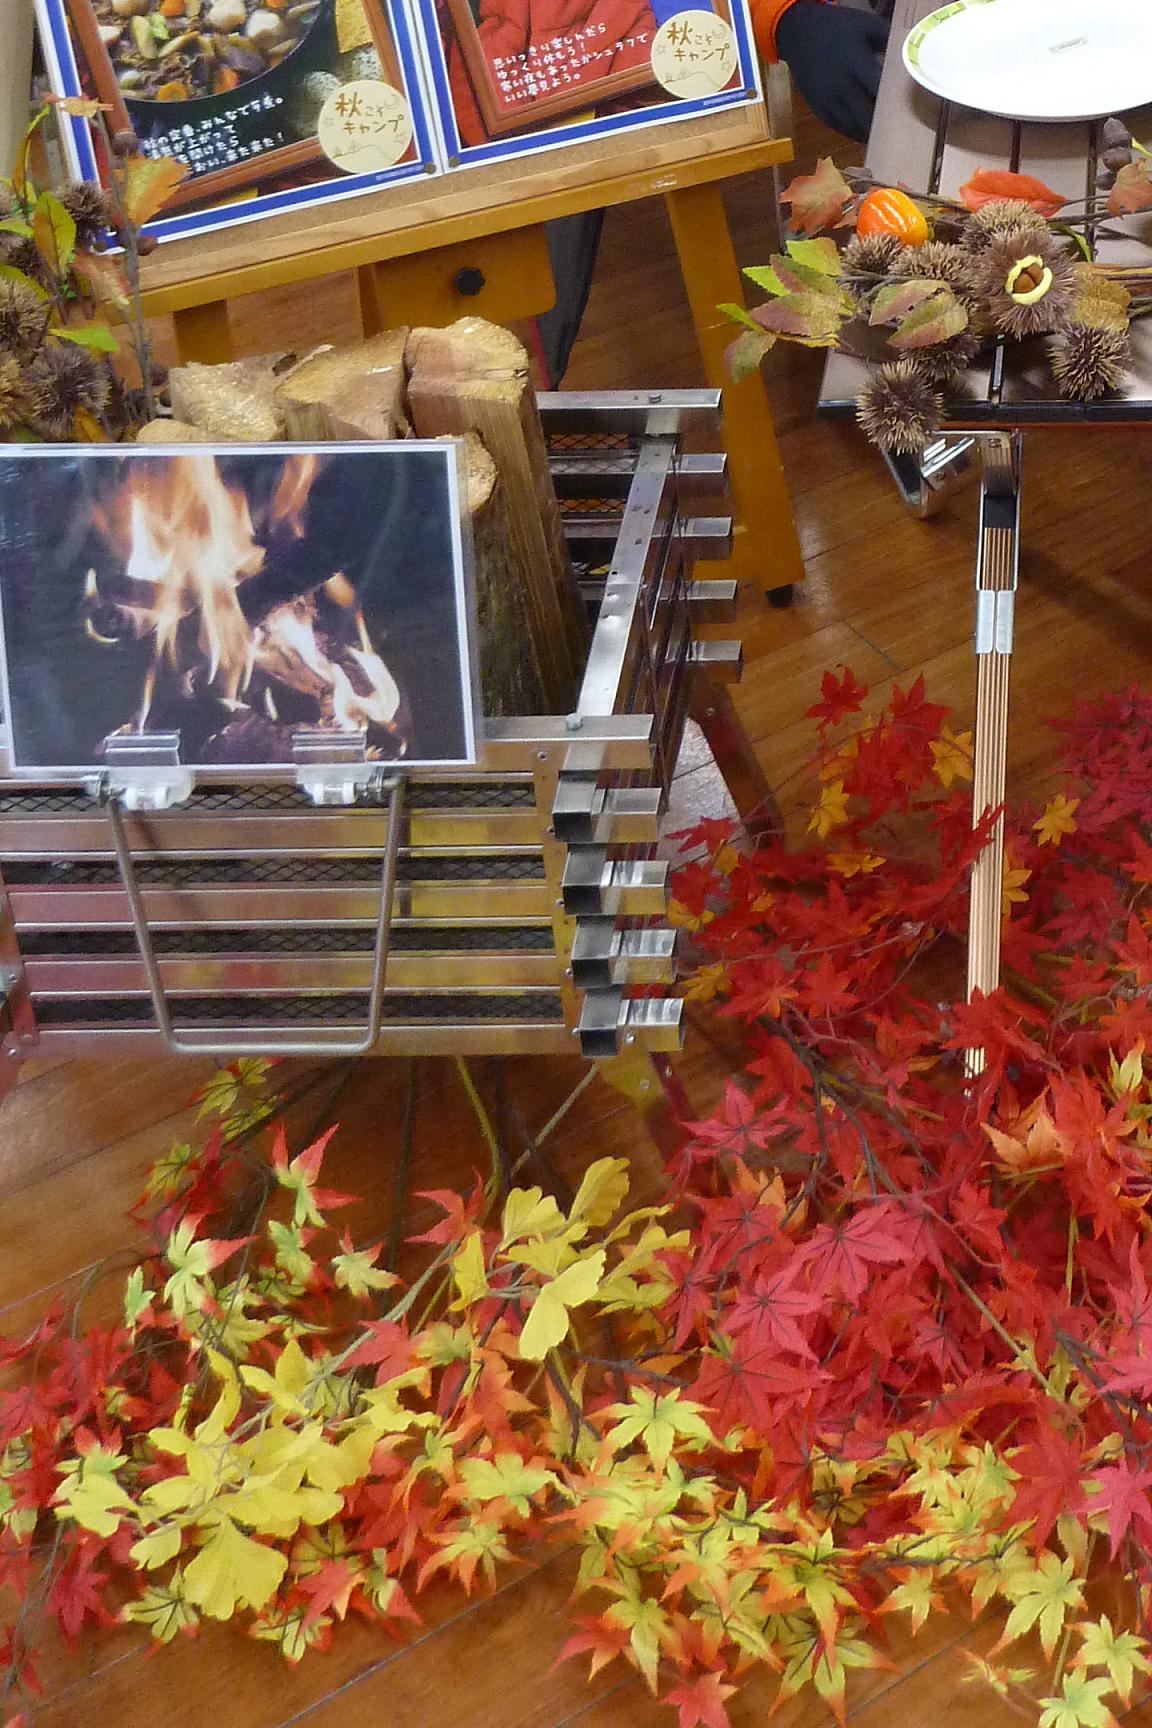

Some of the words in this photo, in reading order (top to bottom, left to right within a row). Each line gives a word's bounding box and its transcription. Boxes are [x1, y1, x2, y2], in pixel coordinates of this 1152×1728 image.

[493, 22, 607, 70] 思いっきり楽しんだら
[667, 21, 712, 46] 秋こそ
[674, 42, 730, 62] キャンプ
[505, 73, 581, 103] いい夢見よう。
[335, 92, 384, 118] 秋こそ
[344, 114, 404, 135] キャンプ
